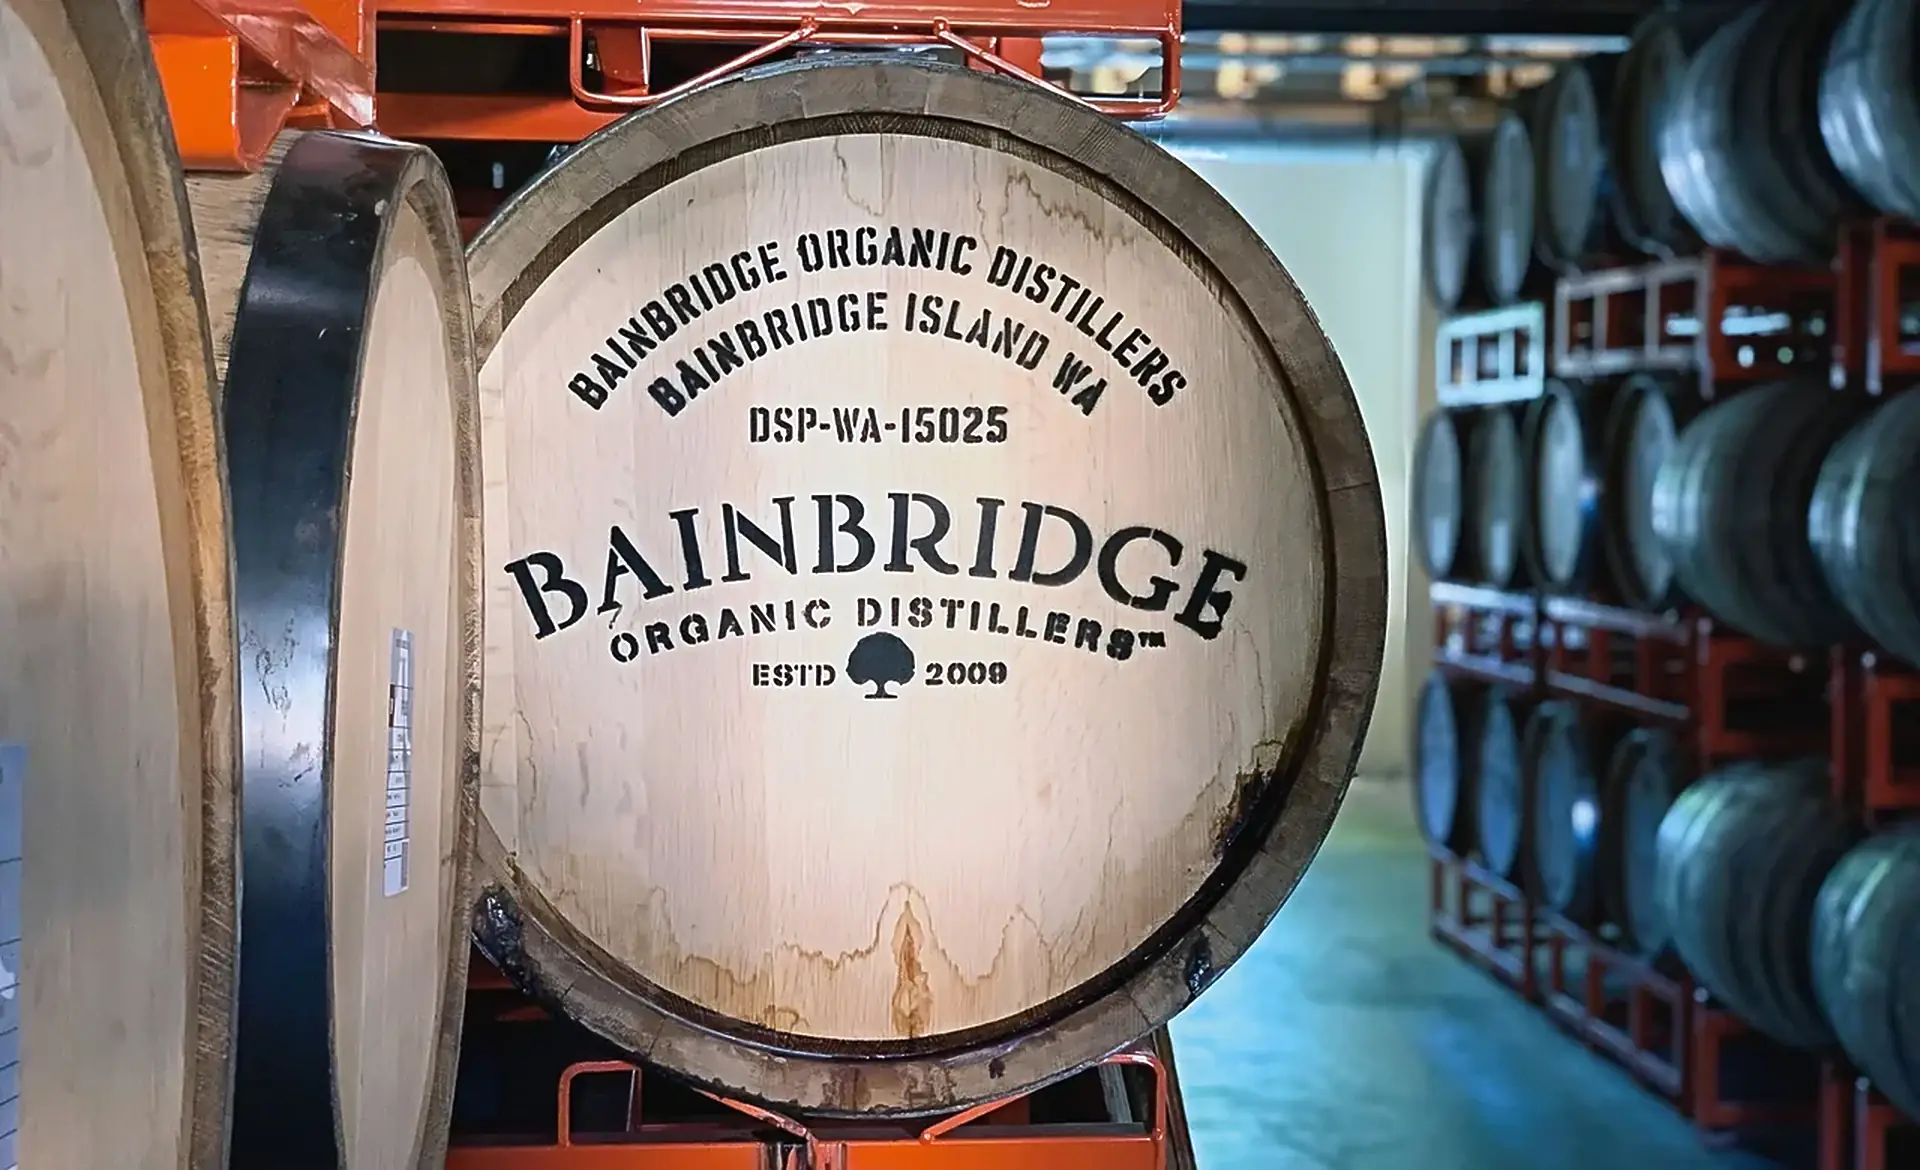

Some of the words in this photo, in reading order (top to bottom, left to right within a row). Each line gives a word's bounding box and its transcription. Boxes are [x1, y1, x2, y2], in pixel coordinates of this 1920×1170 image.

[567, 241, 788, 411] BAINBRIDGE
[796, 225, 978, 276] ORGANIC
[986, 245, 1188, 407] DISTILLERS
[647, 291, 889, 418] BAINBRIDGE
[905, 292, 1050, 371] ISLAND
[1052, 351, 1109, 417] WA
[749, 405, 1010, 444] DSP-WA-15025
[503, 492, 1249, 641] BAINBRIDGE
[610, 598, 832, 663] ORGANIC
[752, 662, 837, 687] ESTD
[925, 661, 1008, 687] 2009
